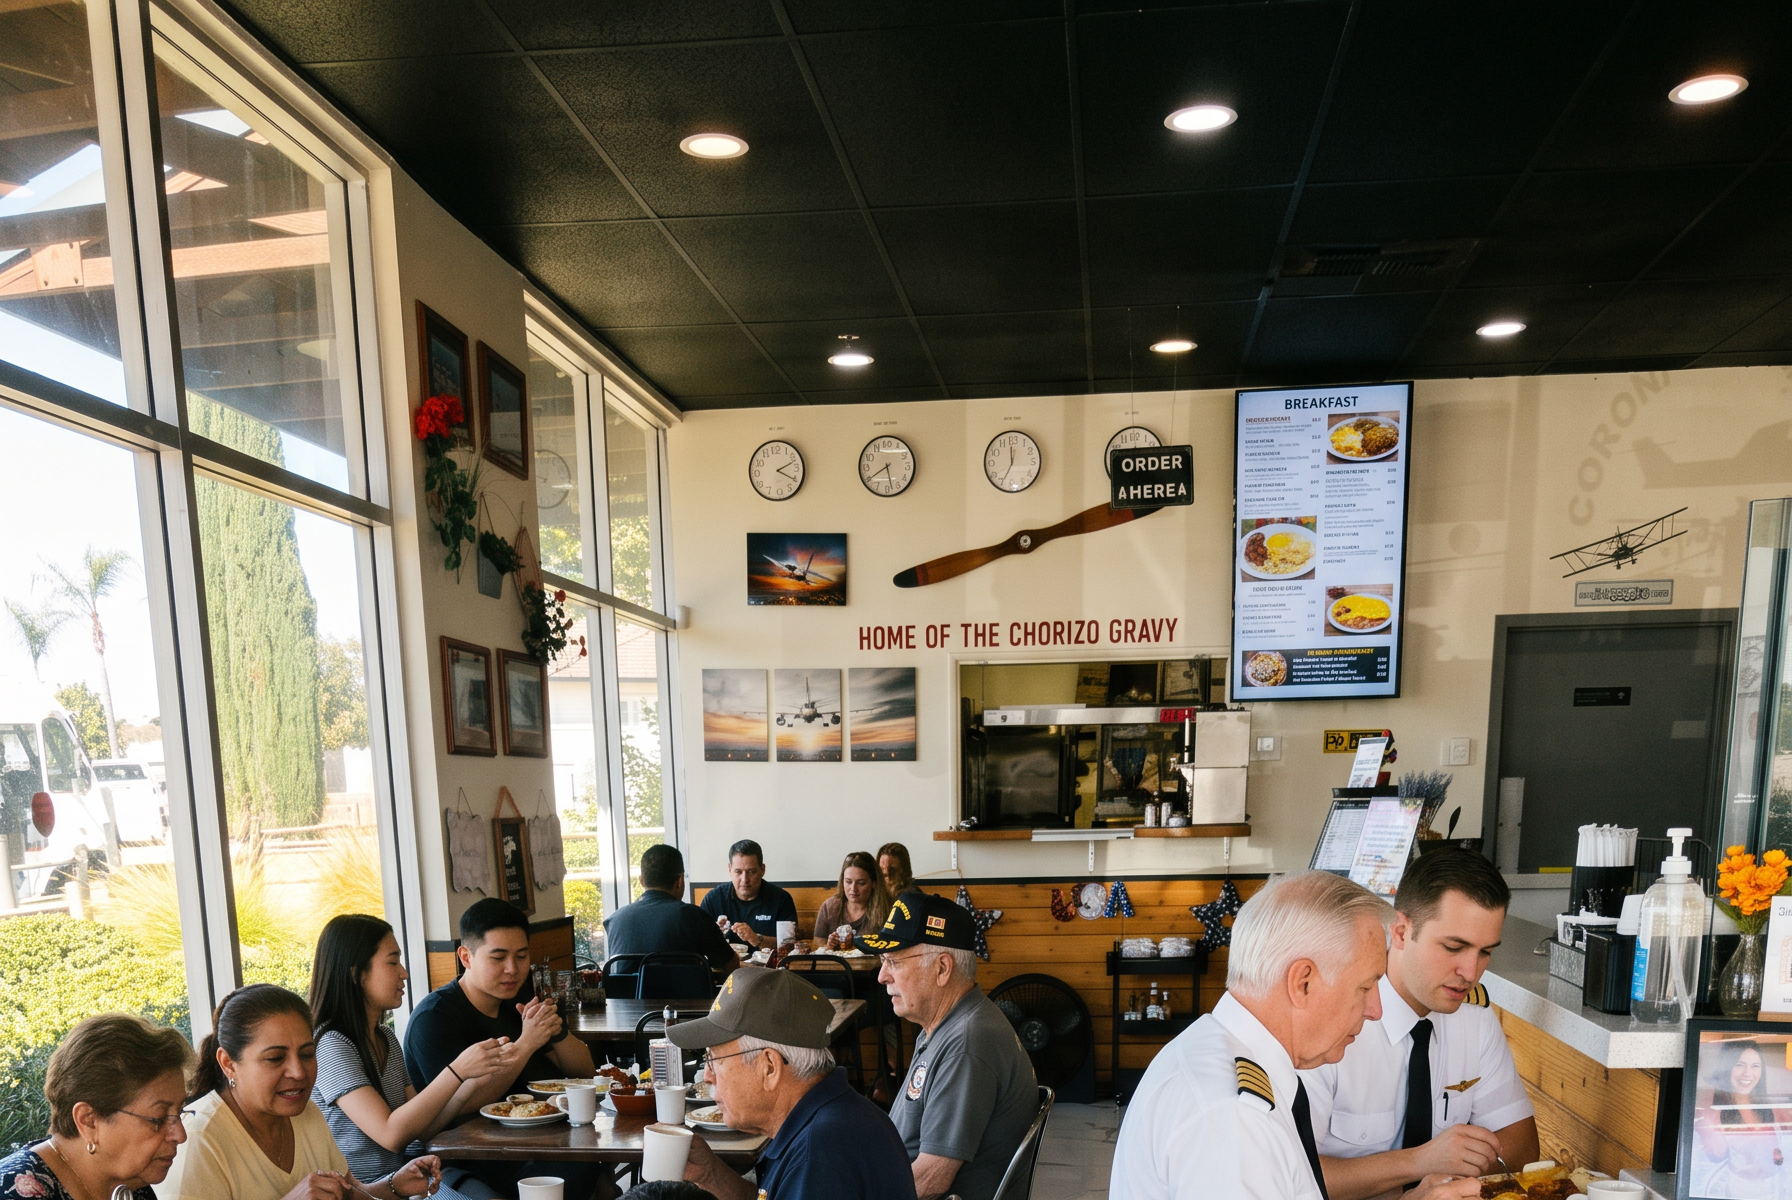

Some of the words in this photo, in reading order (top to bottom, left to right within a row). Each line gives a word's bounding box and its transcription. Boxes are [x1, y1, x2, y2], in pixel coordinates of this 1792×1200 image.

[1284, 396, 1359, 410] BREAKFAST
[1121, 455, 1183, 472] ORDER
[858, 624, 916, 651] HOME
[925, 623, 951, 649] OF
[960, 622, 1000, 648] THE
[1009, 619, 1100, 647] CHORIZO
[1109, 617, 1178, 644] GRAVY
